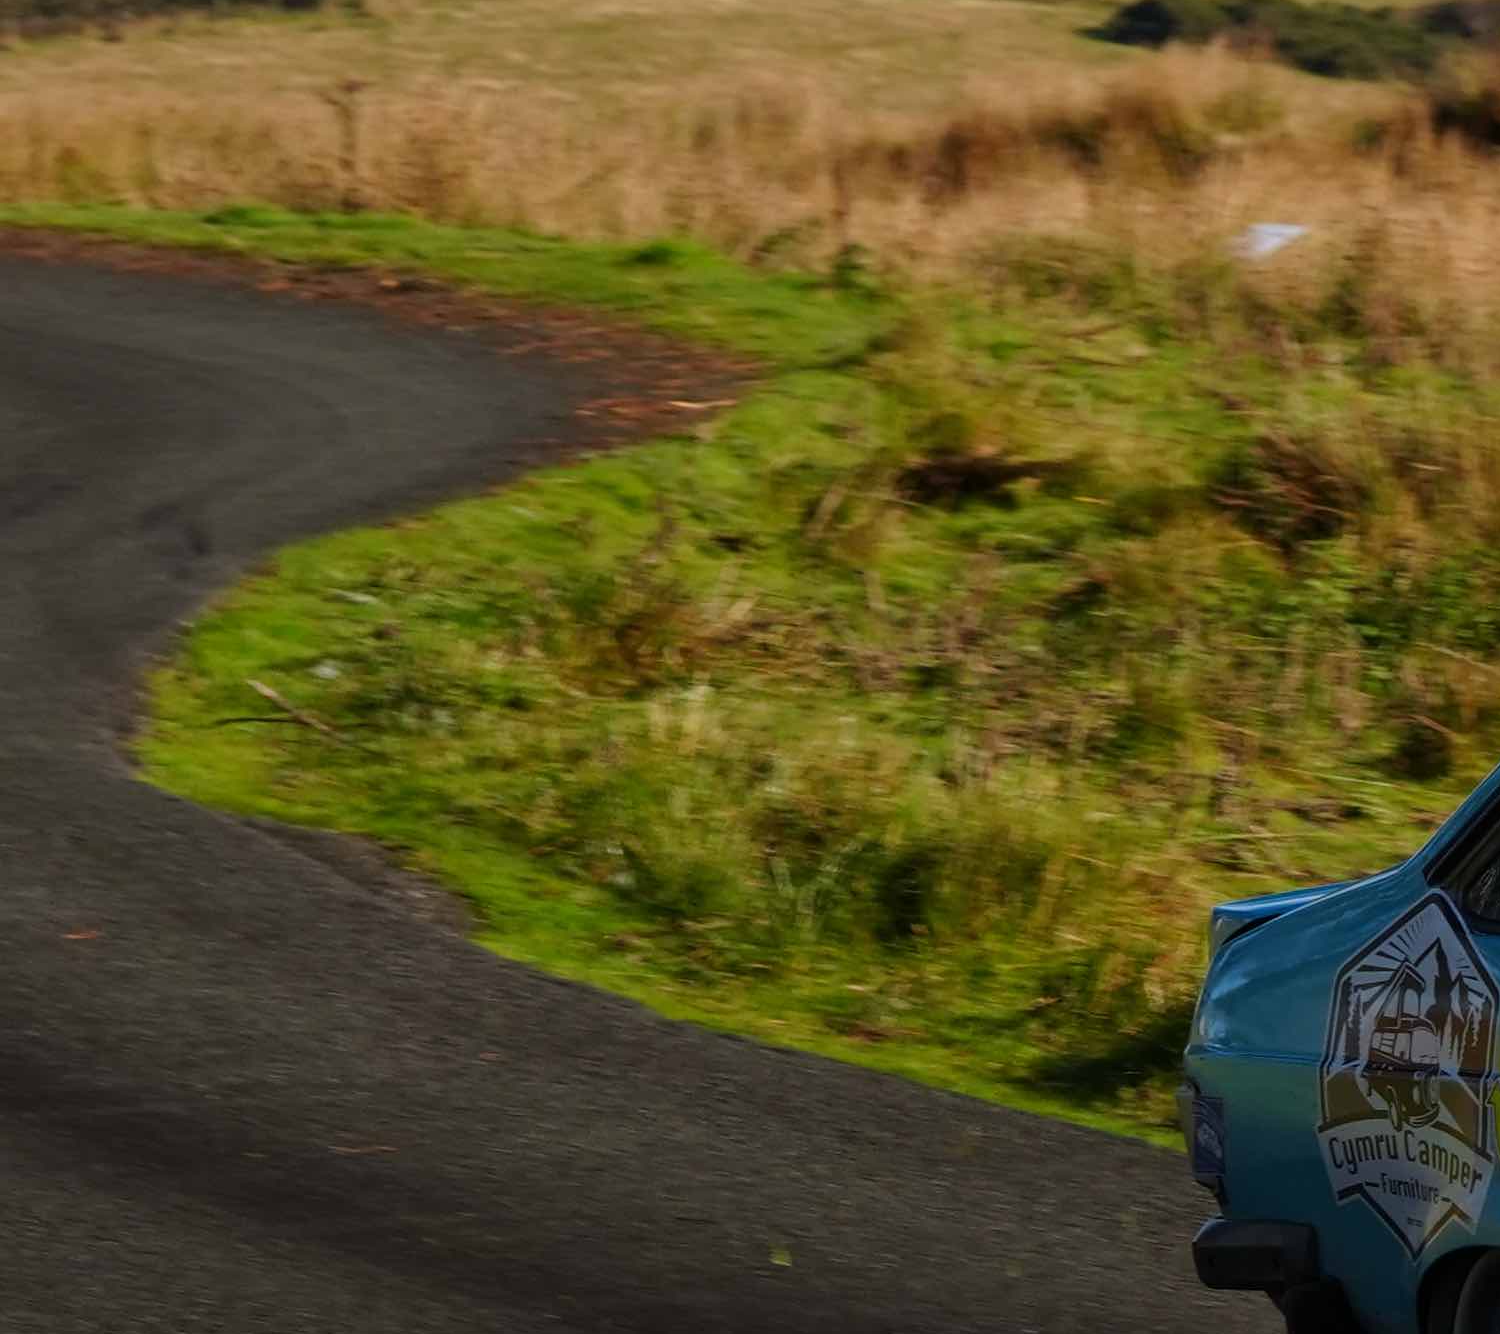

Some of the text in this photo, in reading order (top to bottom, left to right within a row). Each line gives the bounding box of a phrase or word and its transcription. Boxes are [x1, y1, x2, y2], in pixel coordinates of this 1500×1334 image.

[1328, 1130, 1482, 1193] Cymru Camper
[1381, 1173, 1439, 1203] Furniture
